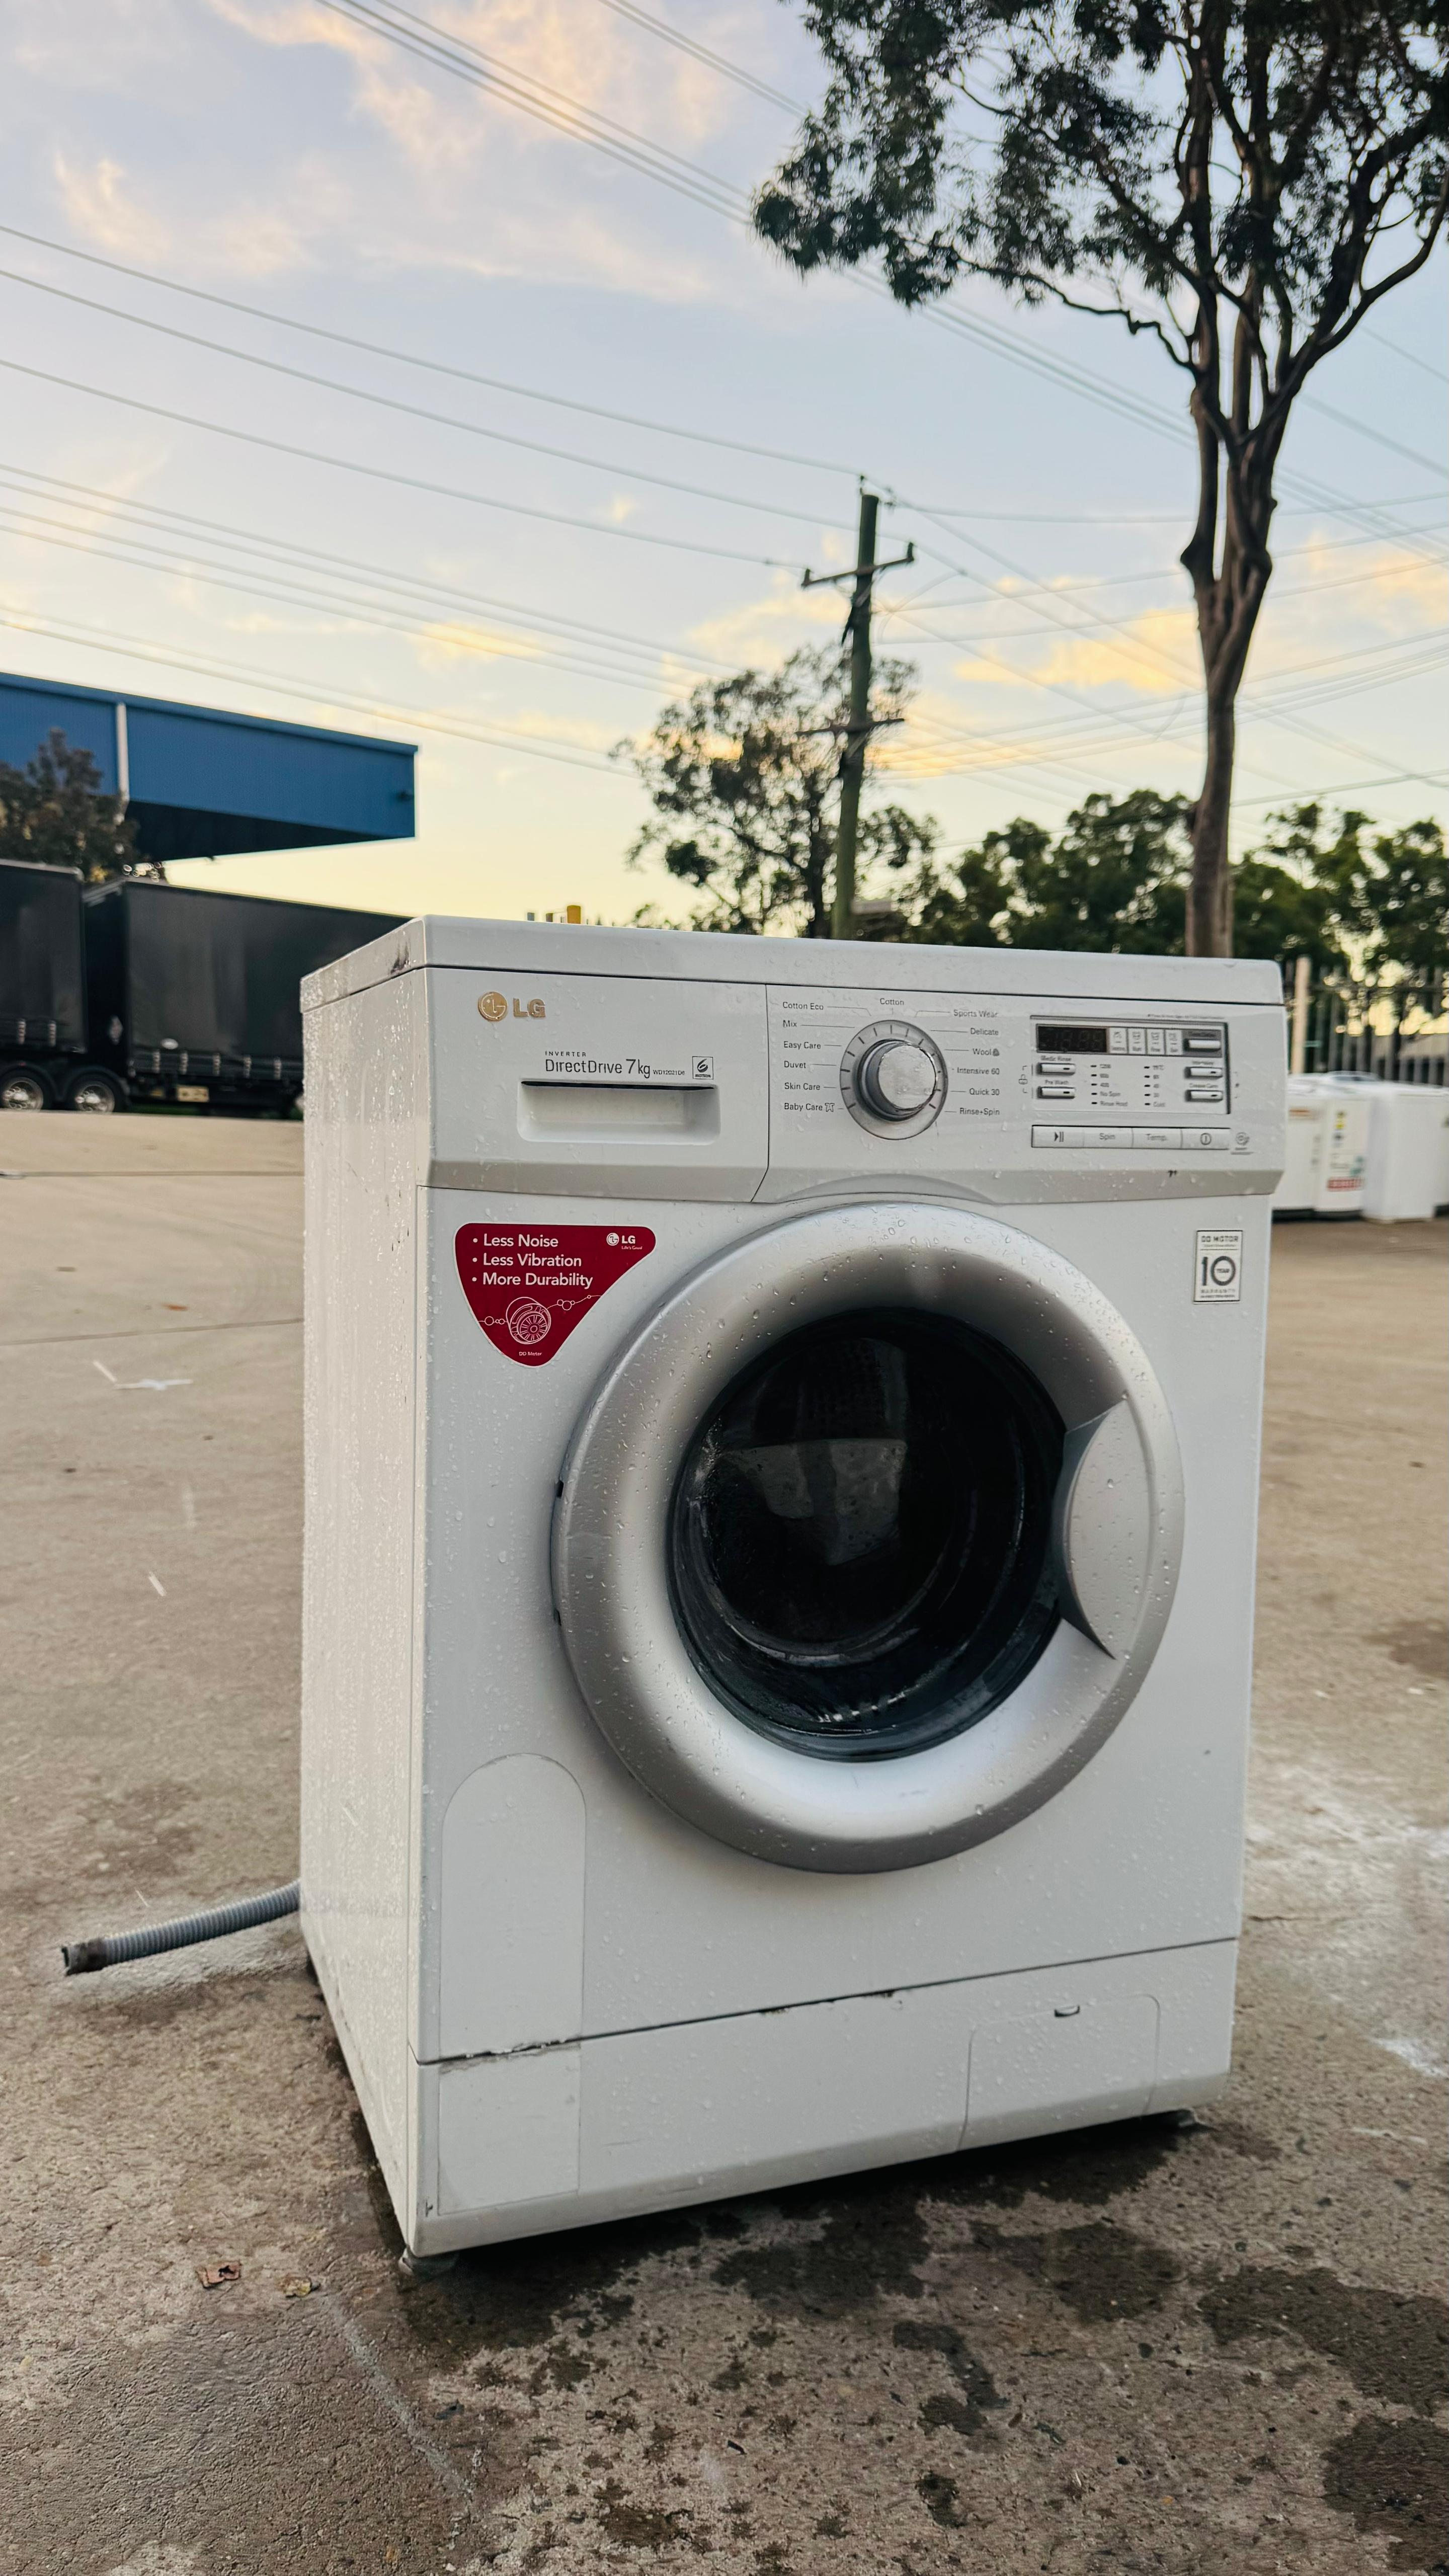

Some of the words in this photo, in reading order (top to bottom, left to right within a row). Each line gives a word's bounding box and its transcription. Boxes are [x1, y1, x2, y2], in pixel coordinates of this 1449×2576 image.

[513, 998, 546, 1018] LG
[783, 1002, 809, 1010] Cotton
[953, 1009, 977, 1018] Sports
[783, 1020, 797, 1028] Mix
[971, 1028, 999, 1036] Delicate
[783, 1041, 801, 1051] Easy
[803, 1041, 821, 1050] Care
[972, 1048, 992, 1056] Wool
[783, 1061, 807, 1069] Duvet
[956, 1067, 989, 1075] Intensive
[784, 1083, 801, 1091] Skin
[969, 1088, 989, 1096] Quick
[784, 1103, 804, 1112] Baby
[806, 1103, 823, 1111] Care
[959, 1107, 1000, 1117] Rinse+Spin
[1099, 1133, 1116, 1141] Spin
[484, 1233, 514, 1247] Less
[518, 1234, 559, 1248] Noise
[621, 1235, 636, 1245] LG
[483, 1253, 514, 1266] Less
[518, 1253, 582, 1267] Vibration
[482, 1272, 521, 1285] More
[525, 1272, 594, 1290] Durability
